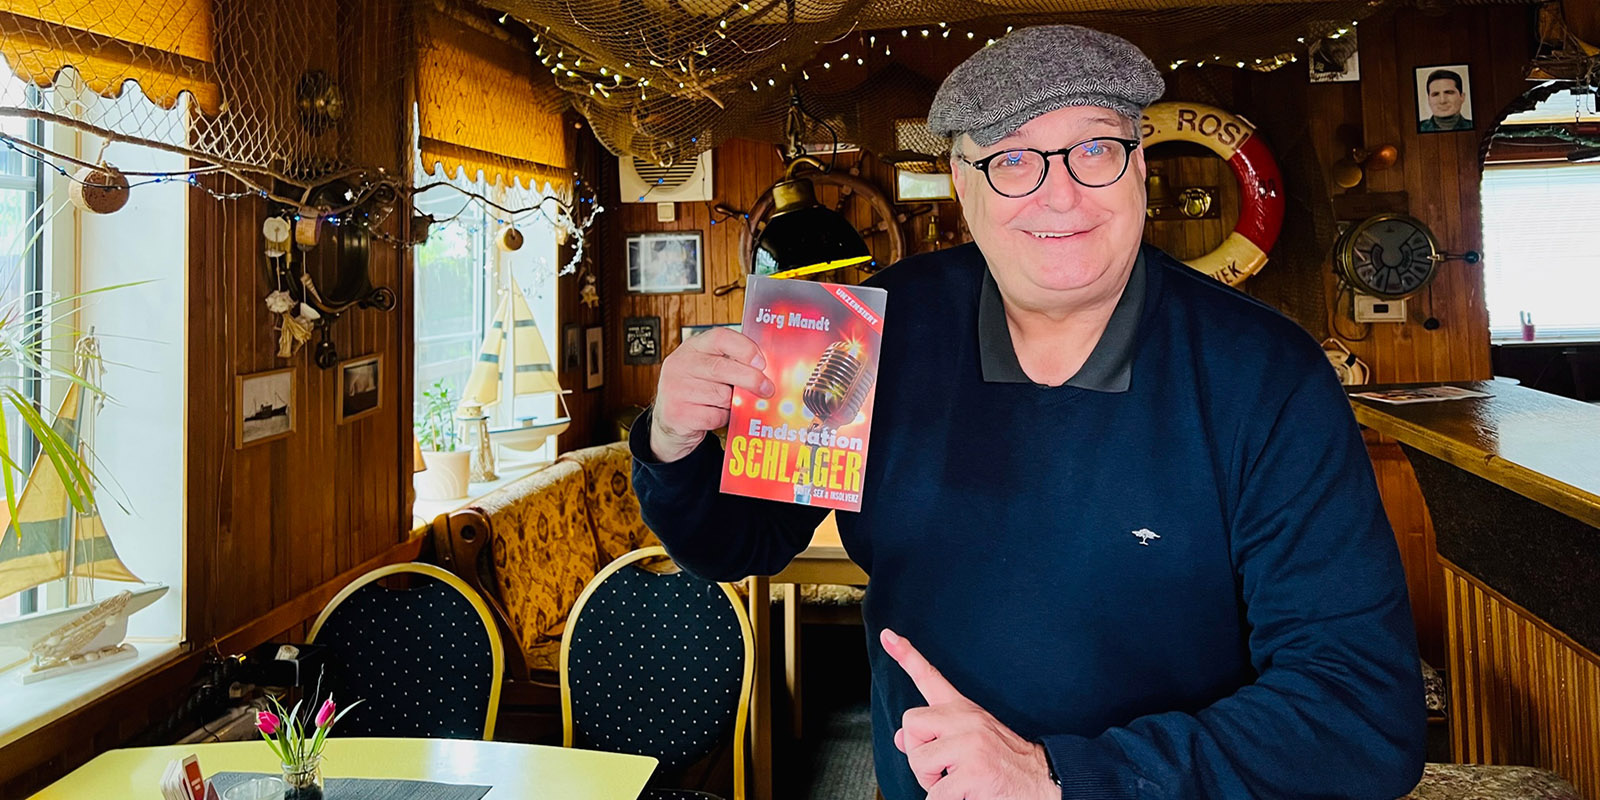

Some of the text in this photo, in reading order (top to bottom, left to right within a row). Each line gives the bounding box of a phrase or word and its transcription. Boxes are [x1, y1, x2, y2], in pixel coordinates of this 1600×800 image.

[1177, 109, 1250, 151] ROSI
[755, 308, 830, 331] Jörg Mandt
[835, 288, 878, 325] UNZENSIERT
[748, 418, 863, 451] Endstation
[728, 435, 862, 492] SCHLAGER
[812, 488, 825, 498] SEX
